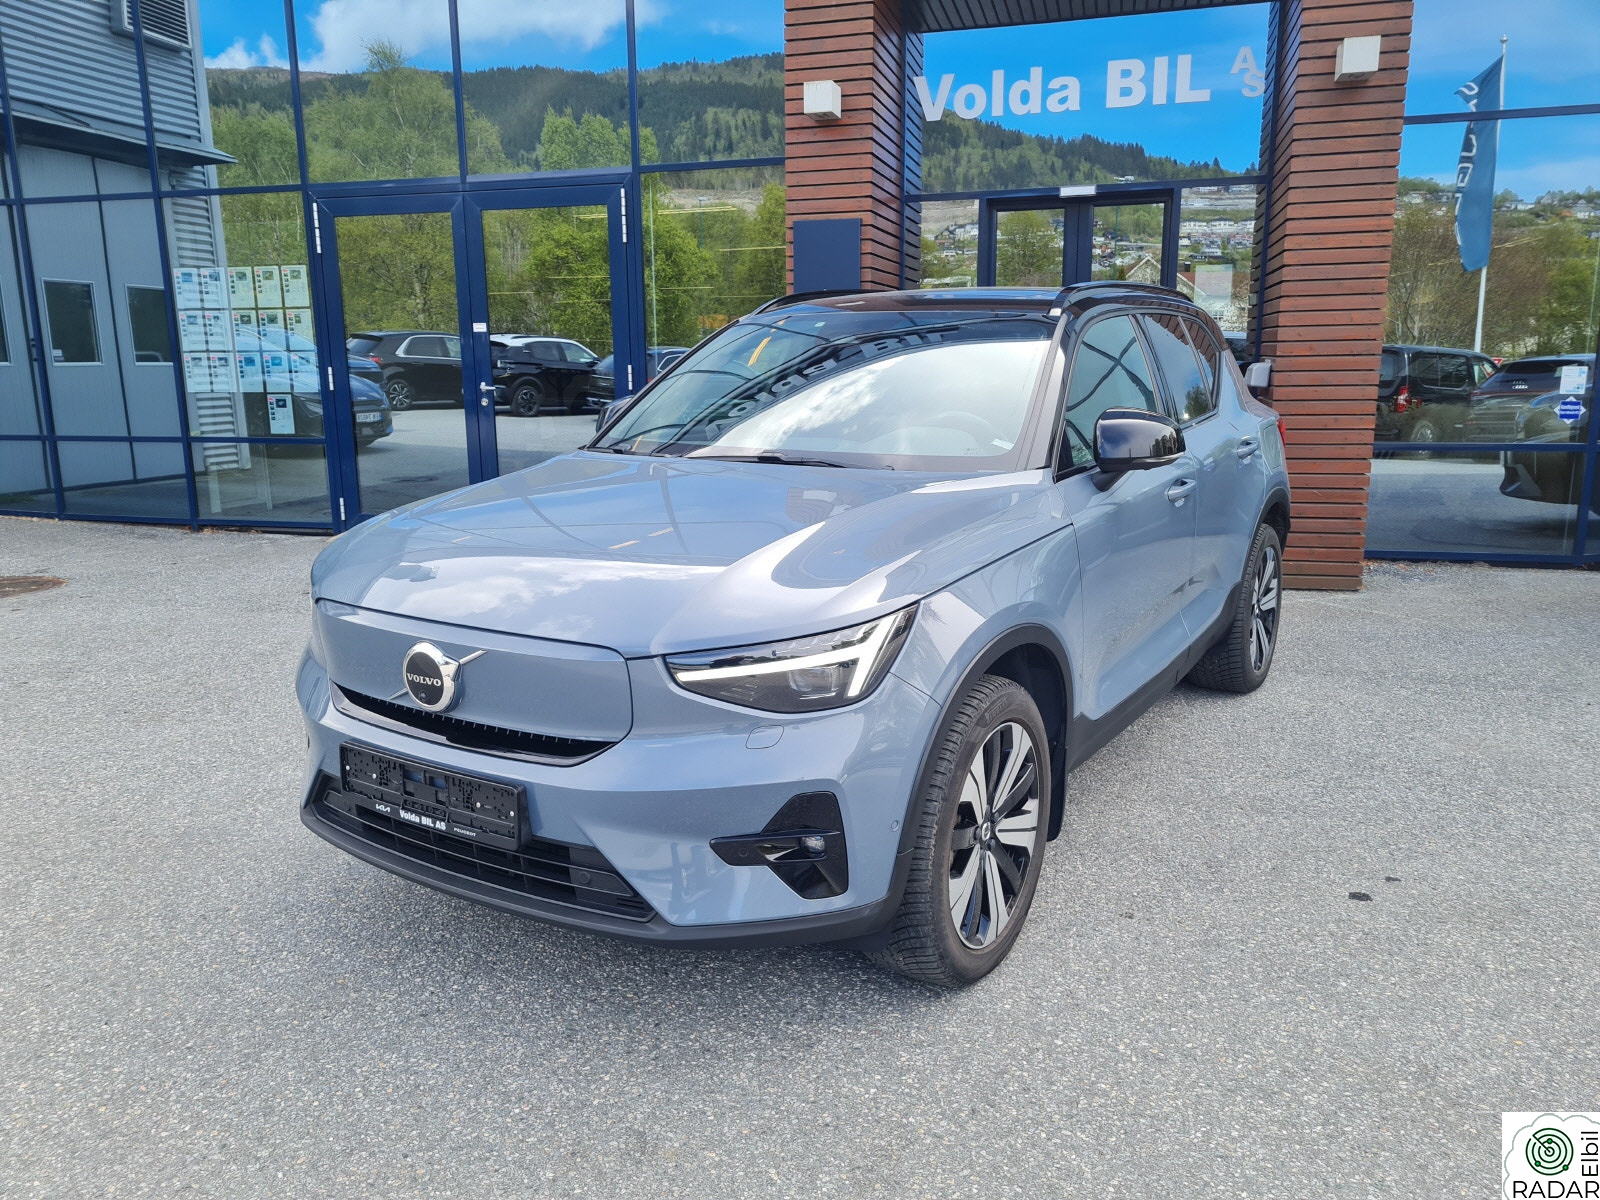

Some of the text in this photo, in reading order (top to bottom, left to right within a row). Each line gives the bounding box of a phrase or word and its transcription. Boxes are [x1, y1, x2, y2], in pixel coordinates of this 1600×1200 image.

[912, 66, 1081, 122] Volda
[1105, 54, 1211, 109] BIL
[406, 672, 442, 687] VOLVO
[375, 803, 391, 813] KIA
[399, 809, 447, 831] Volda BIL AS
